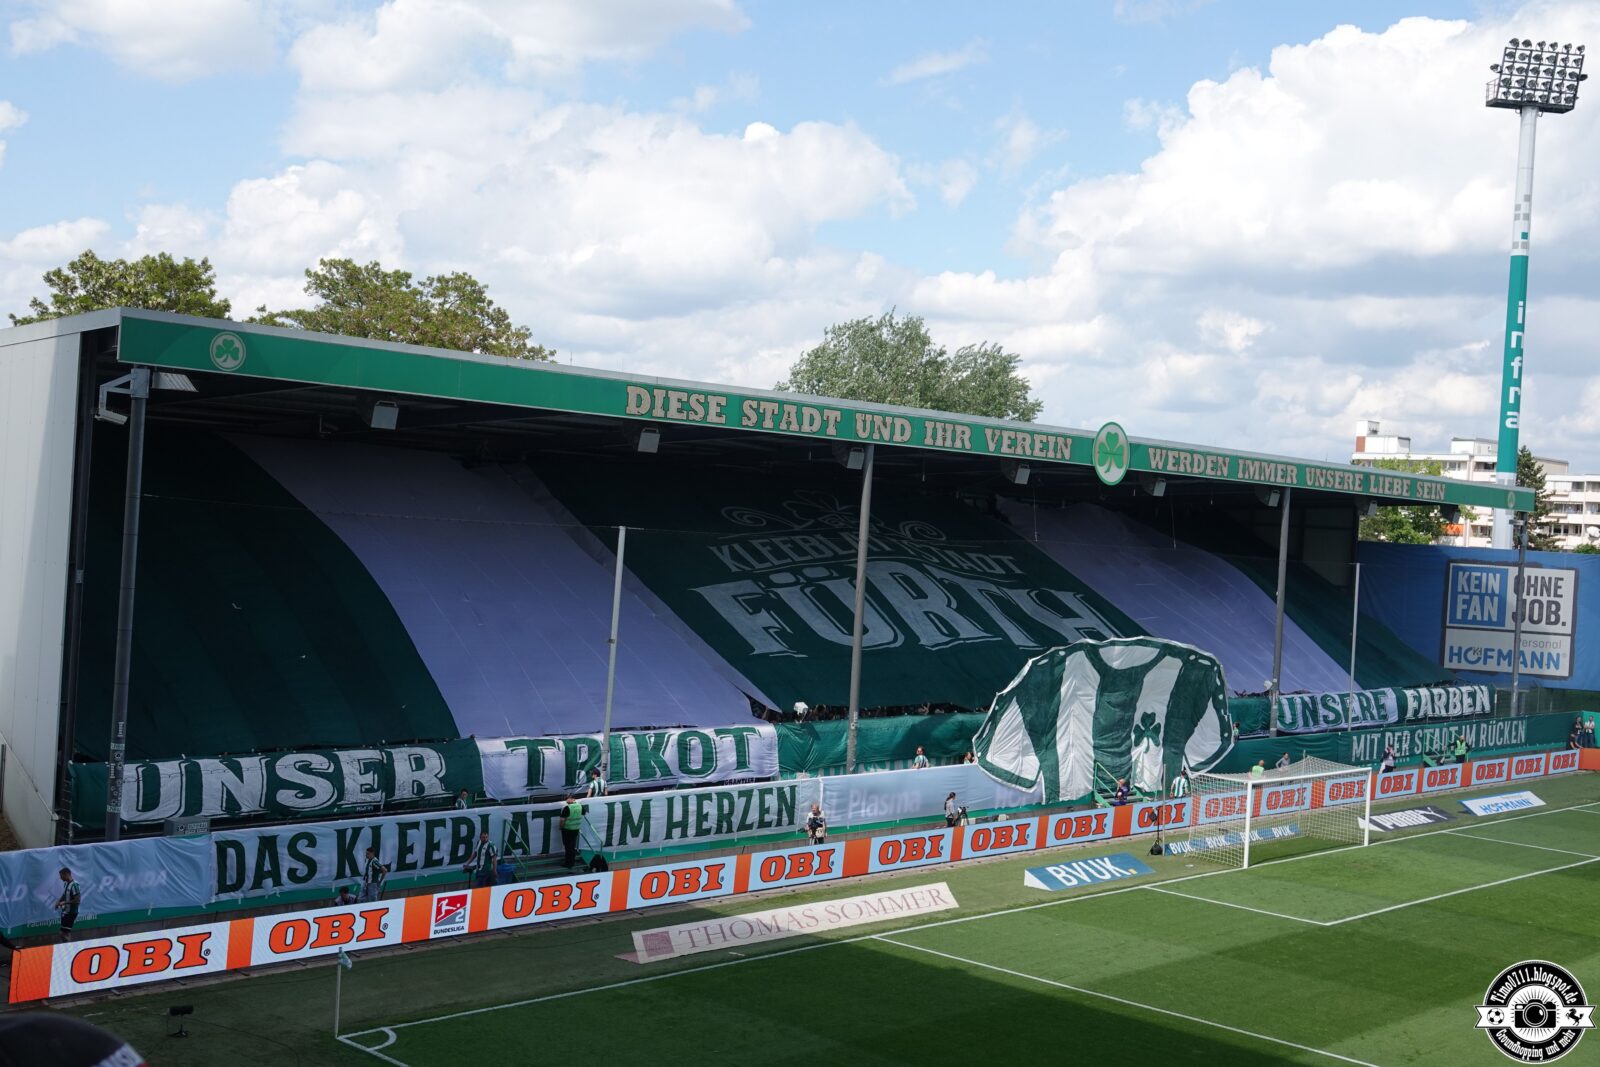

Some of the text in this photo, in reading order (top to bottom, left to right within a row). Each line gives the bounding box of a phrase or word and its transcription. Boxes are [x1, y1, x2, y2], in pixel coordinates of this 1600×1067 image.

[1505, 301, 1524, 429] infra
[625, 385, 1446, 500] DIESE STADT UND IHR VEREIN WERDEN IMMER UNSERE LIEBE SEIN
[1457, 571, 1500, 595] KEIN
[1514, 574, 1564, 598] OHNE
[688, 560, 1128, 658] FÜRTH
[1456, 595, 1499, 622] FAN
[1519, 638, 1562, 649] ersonal
[1277, 685, 1491, 731] UNSERE FARBEN
[1351, 733, 1381, 762] MIT
[1414, 727, 1458, 755] STADT
[1479, 720, 1526, 747] RÜCKEN
[1476, 761, 1505, 780] OBI
[1515, 756, 1543, 775] OBI
[1552, 751, 1577, 769] OBI
[120, 726, 763, 825] UNSER TRIKOT
[1380, 773, 1413, 794] OBI
[1427, 766, 1458, 787] OBI
[1266, 787, 1307, 810] OBI
[1329, 782, 1365, 801] OBI
[1137, 803, 1187, 829] OBI
[1205, 795, 1247, 818] OBI
[1480, 798, 1535, 814] HOFMANN
[216, 832, 318, 895] DAS
[603, 799, 653, 847] IM
[664, 785, 797, 841] HERZEN
[970, 823, 1031, 852] OBI
[1054, 813, 1108, 840] OBI
[878, 835, 944, 866] OBI
[760, 848, 835, 882] OBI
[1045, 857, 1137, 888] BVUK.
[640, 864, 725, 899] OBI
[502, 880, 600, 919] OBI
[455, 908, 464, 922] 2
[678, 888, 950, 950] THOMAS SOMMER
[269, 908, 390, 954] OBI
[433, 925, 465, 935] BUNDESLIGA
[71, 932, 212, 984] OBI
